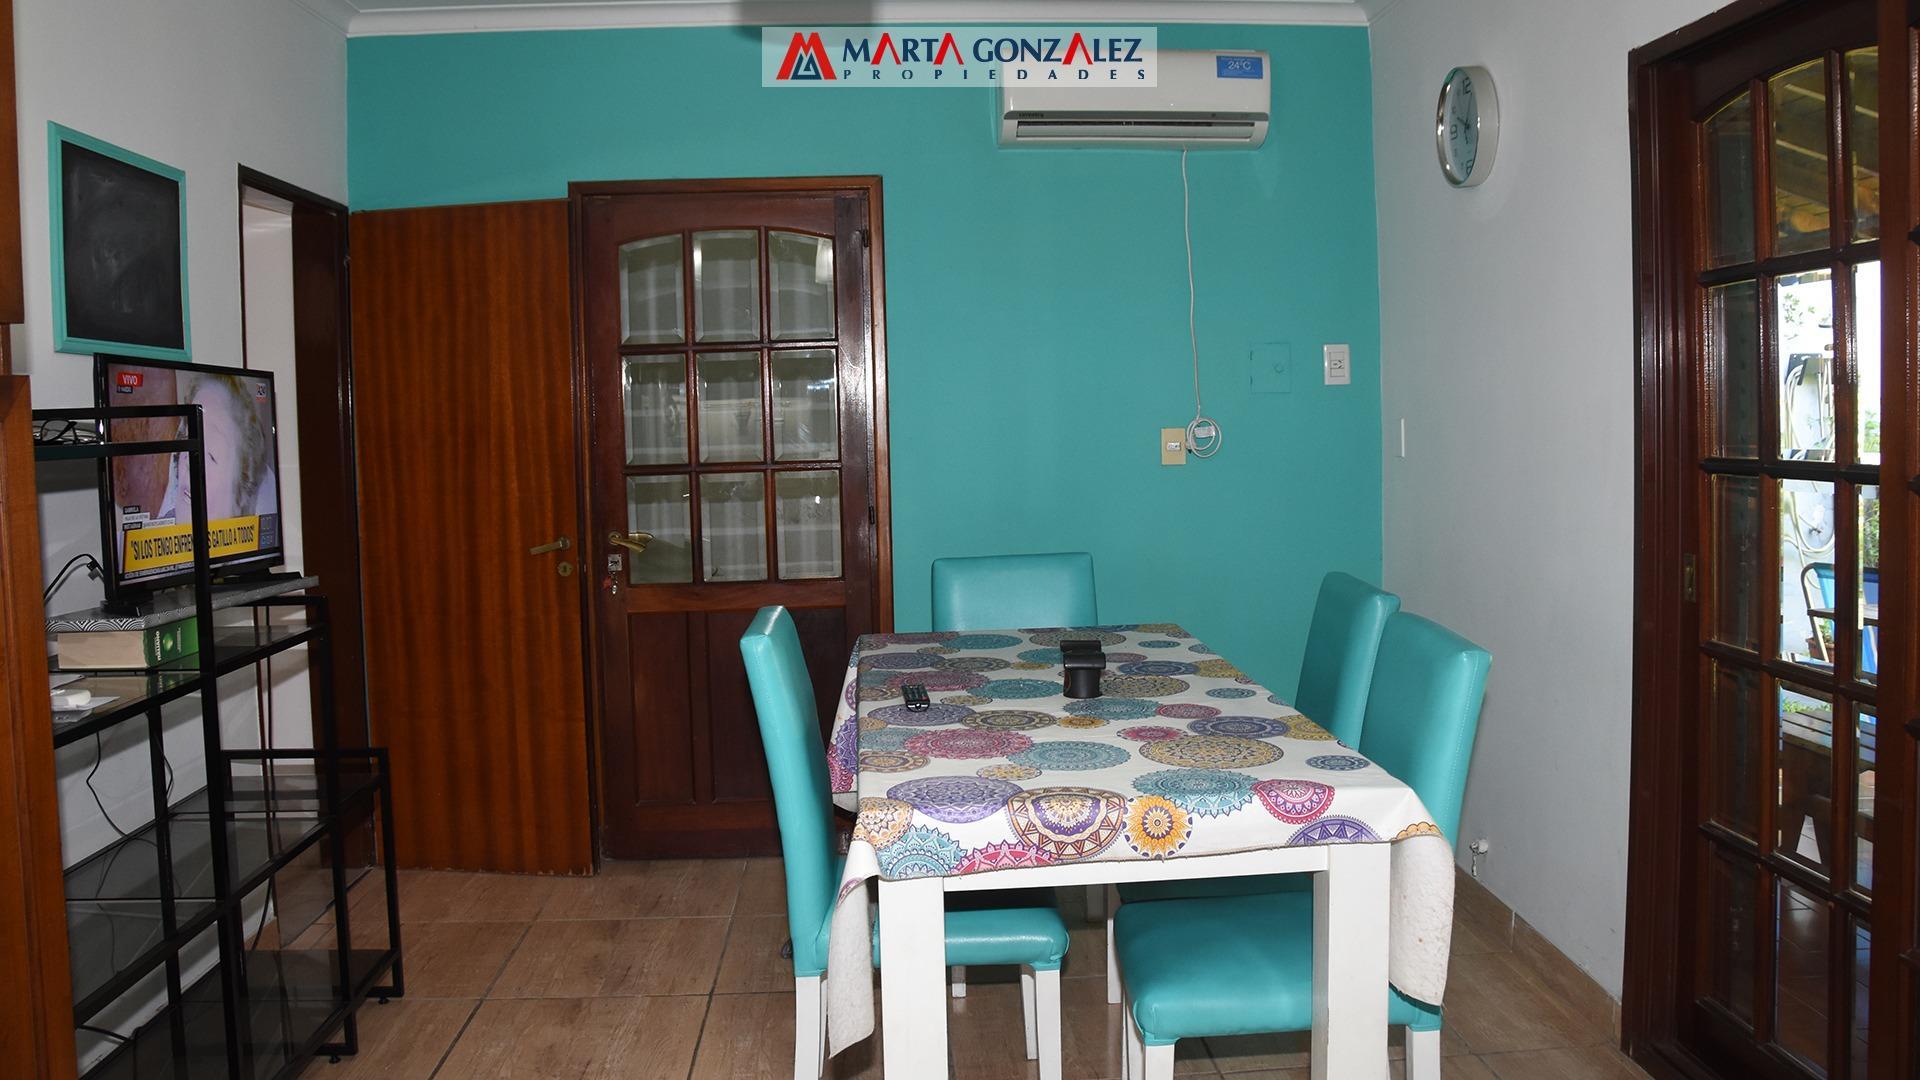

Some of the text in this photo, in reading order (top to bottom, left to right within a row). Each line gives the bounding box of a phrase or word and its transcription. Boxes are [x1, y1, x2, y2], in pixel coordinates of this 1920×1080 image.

[122, 373, 138, 385] VIVO
[141, 538, 153, 560] LOS
[153, 536, 173, 557] TENGO
[174, 533, 193, 554] ENFRE
[212, 528, 232, 548] GATILLO
[233, 527, 238, 545] A
